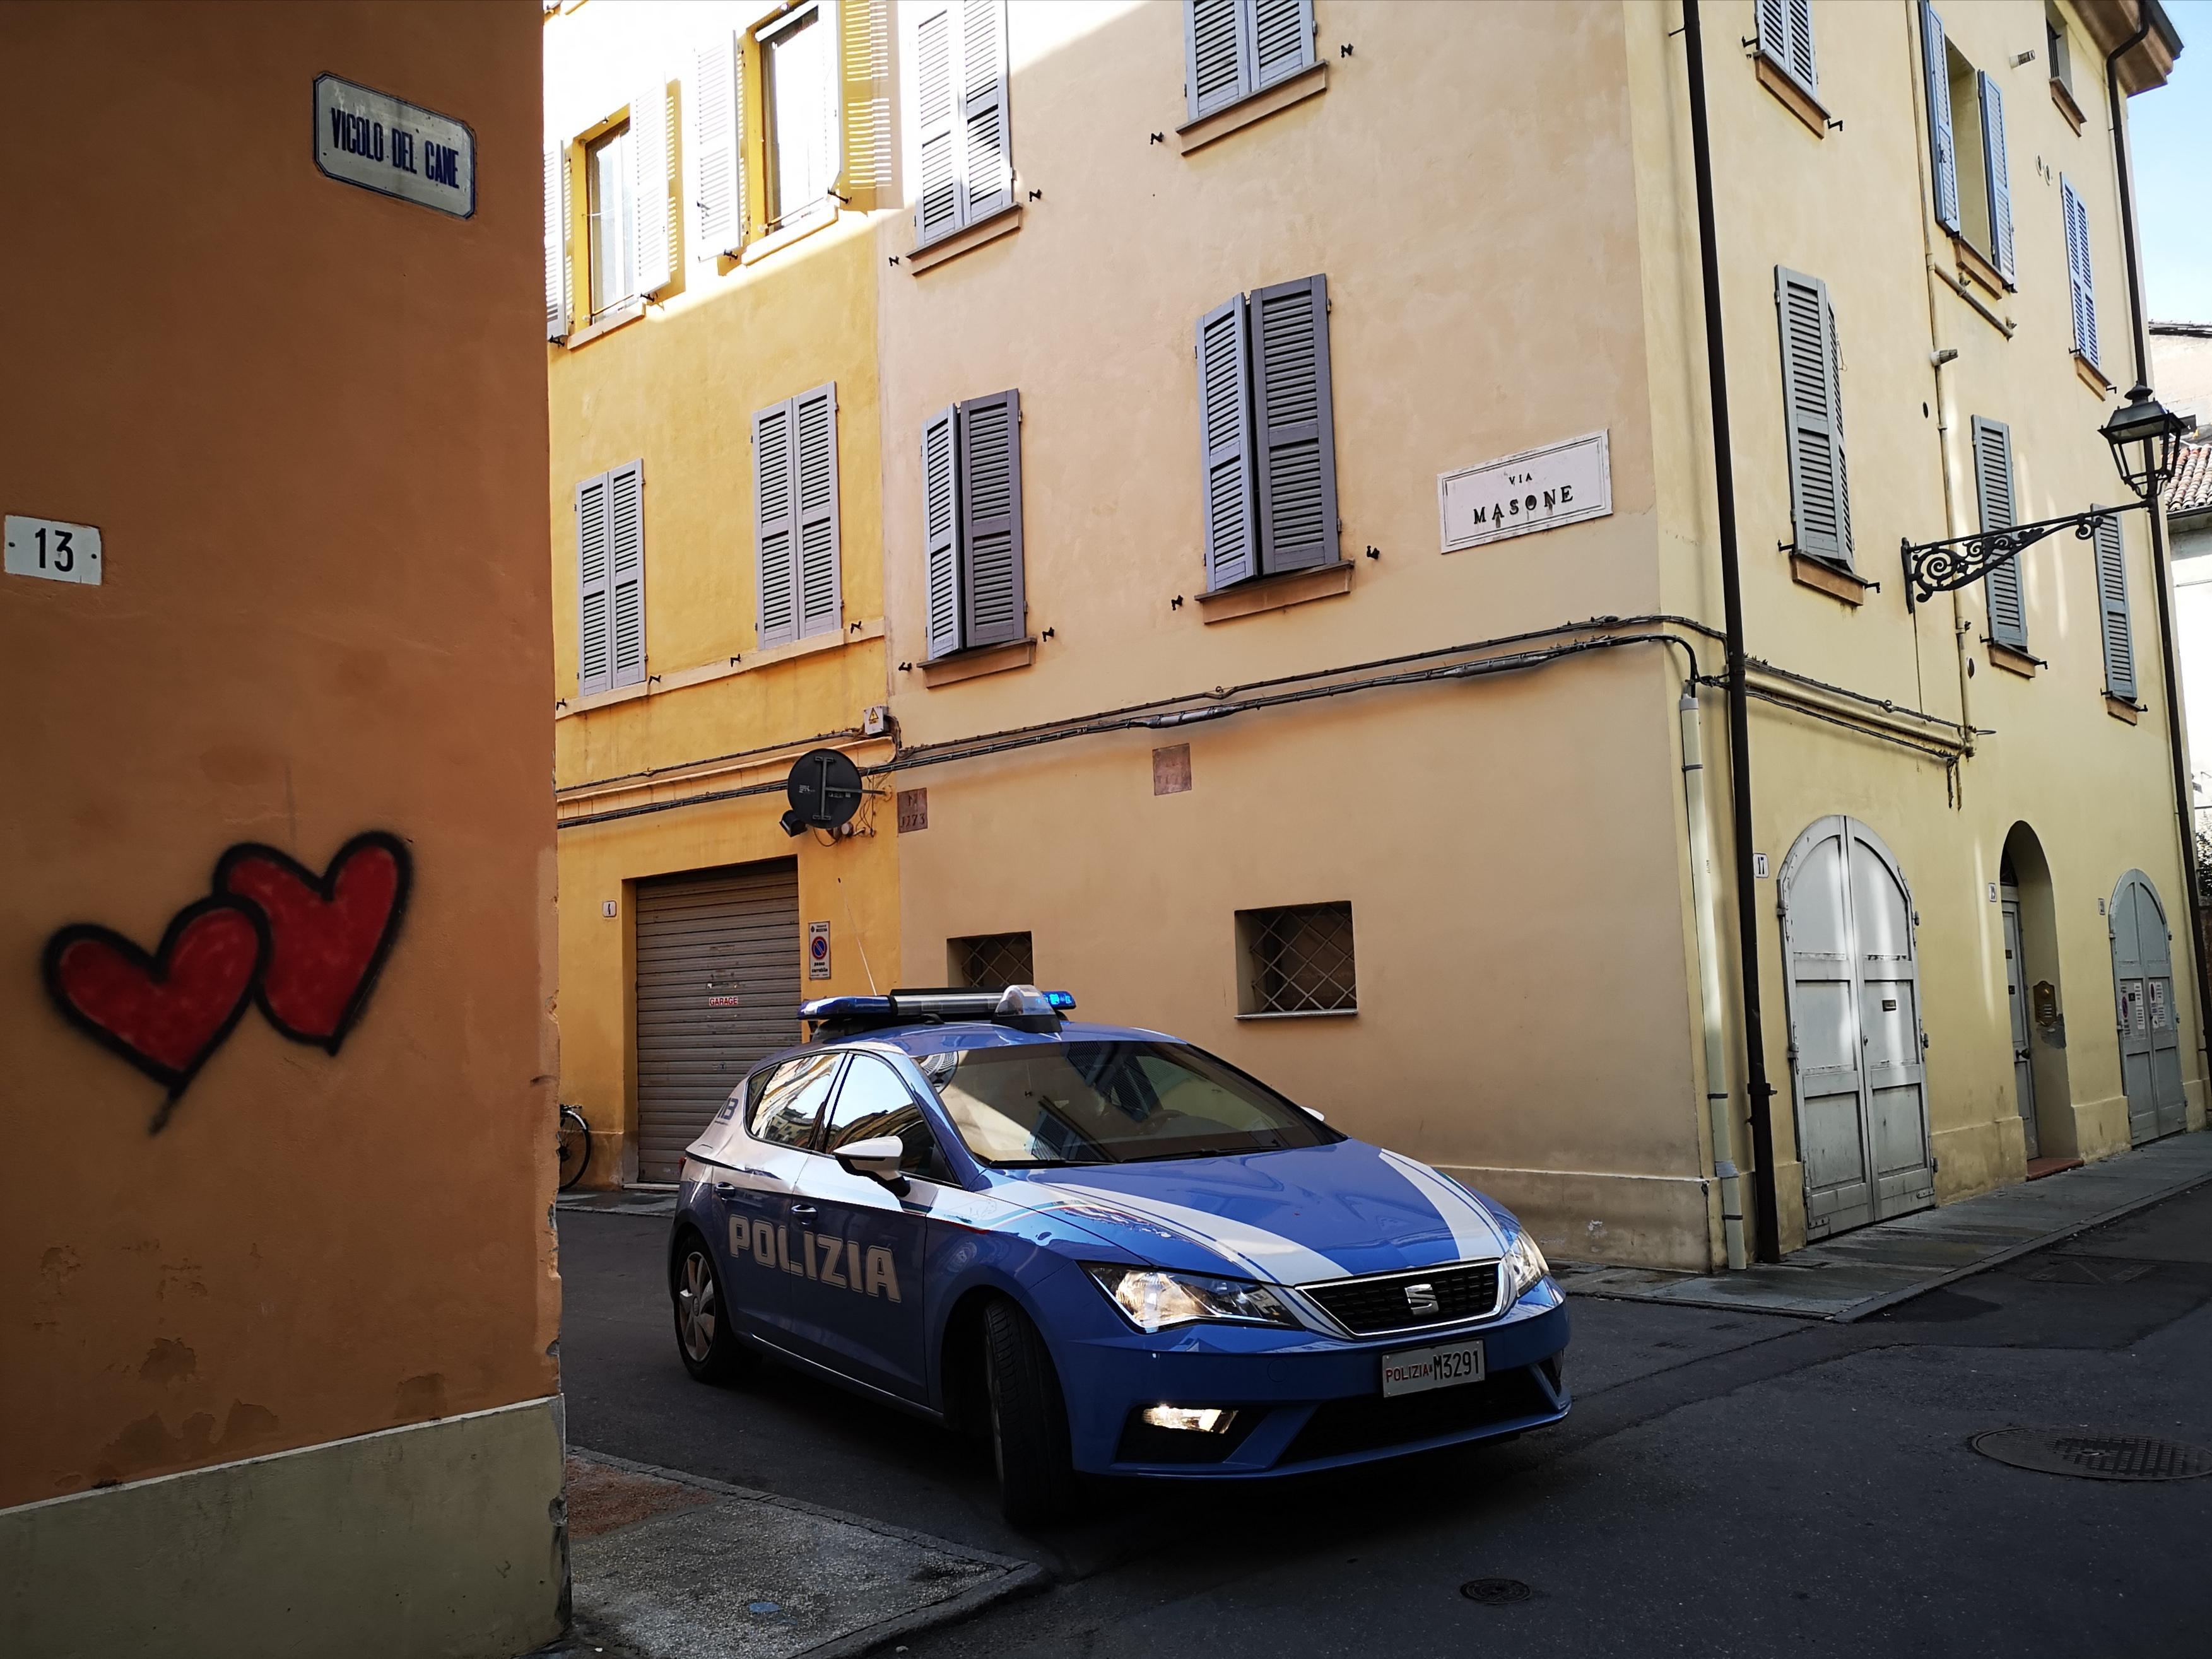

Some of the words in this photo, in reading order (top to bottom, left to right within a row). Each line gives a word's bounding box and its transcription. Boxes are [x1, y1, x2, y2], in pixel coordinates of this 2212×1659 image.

[331, 107, 384, 162] VICOLO
[392, 127, 417, 174] DEL
[425, 140, 459, 189] CANE
[1509, 472, 1533, 485] VIA
[1473, 485, 1574, 524] MASONE
[35, 527, 74, 572] 13
[1757, 856, 1765, 875] 17
[710, 997, 738, 1005] GARAGE
[729, 1214, 902, 1303] POLIZIA
[1385, 1363, 1429, 1383] POLIZIA
[1433, 1350, 1479, 1380] M3291
